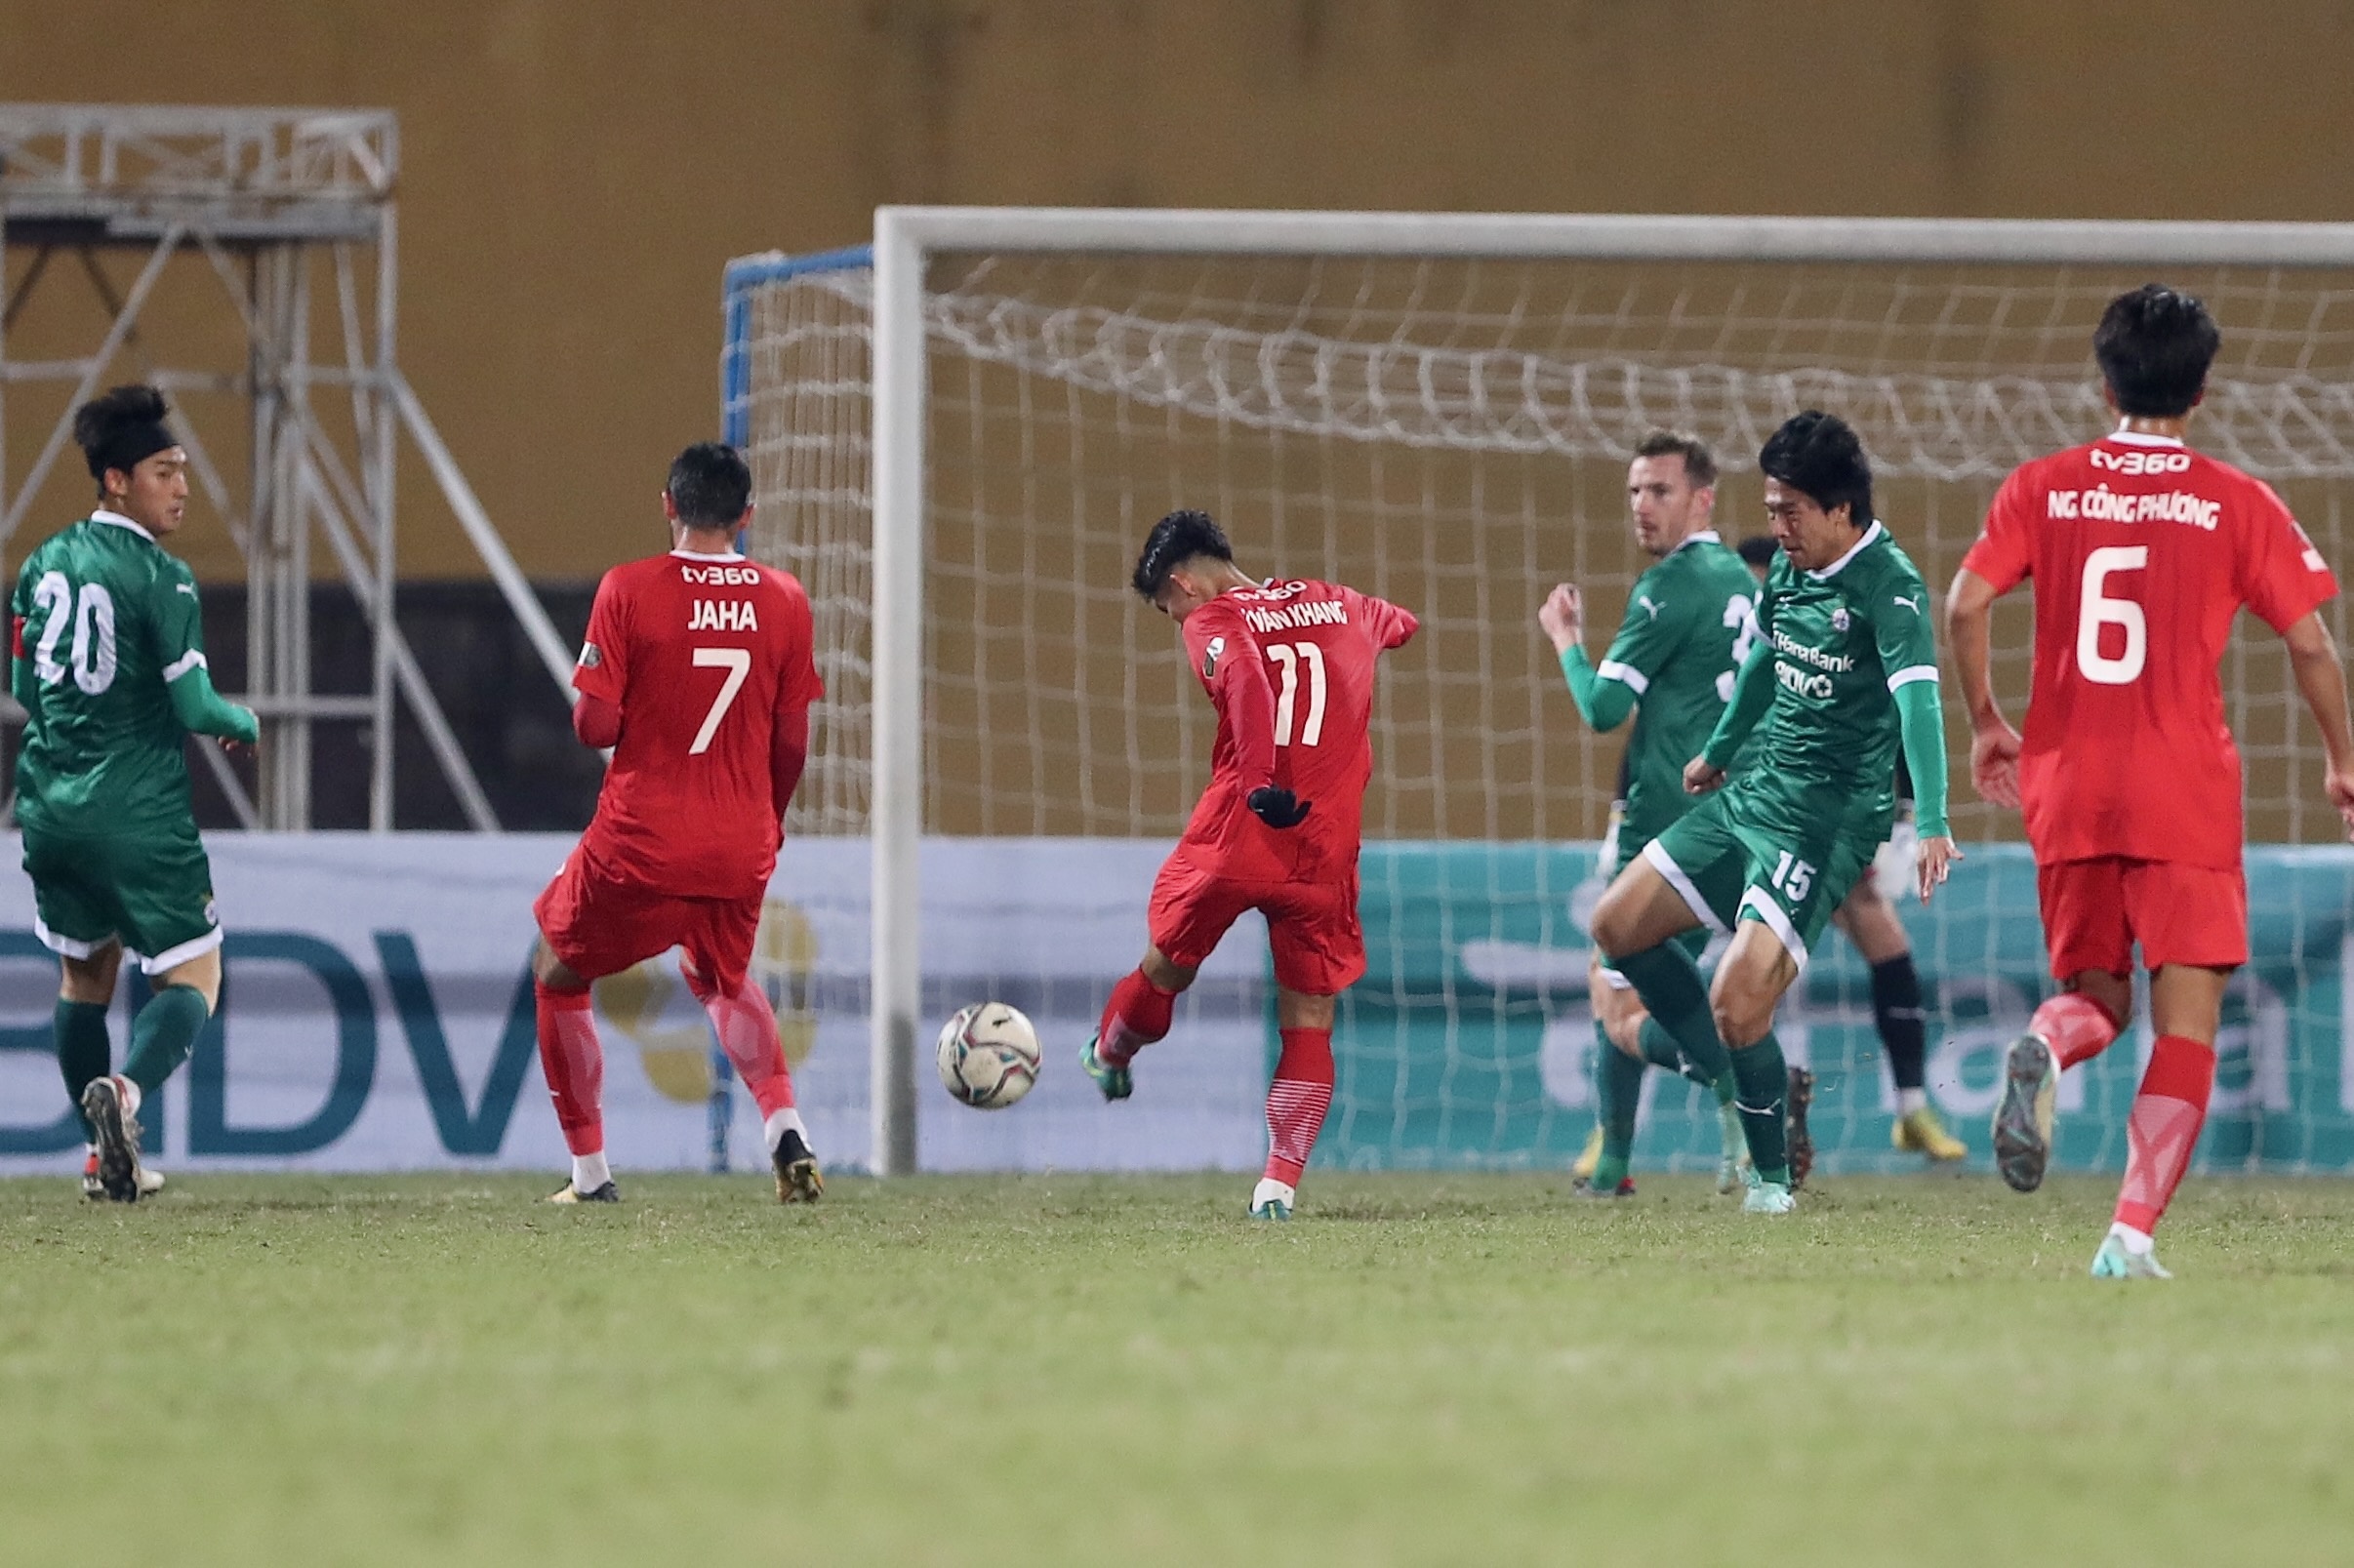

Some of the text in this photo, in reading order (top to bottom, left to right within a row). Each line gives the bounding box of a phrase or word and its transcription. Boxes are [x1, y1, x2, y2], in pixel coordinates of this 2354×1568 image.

[2089, 448, 2191, 475] tv360
[2047, 489, 2079, 520] NG
[2081, 482, 2137, 524] CÔNG
[680, 564, 761, 586] tv360
[33, 570, 117, 696] 20
[687, 598, 758, 632] JAHA
[1286, 600, 1349, 627] KHANG
[2076, 544, 2149, 686] 6
[687, 646, 751, 756] 7
[1266, 640, 1327, 747] 11
[1770, 849, 1818, 903] 15
